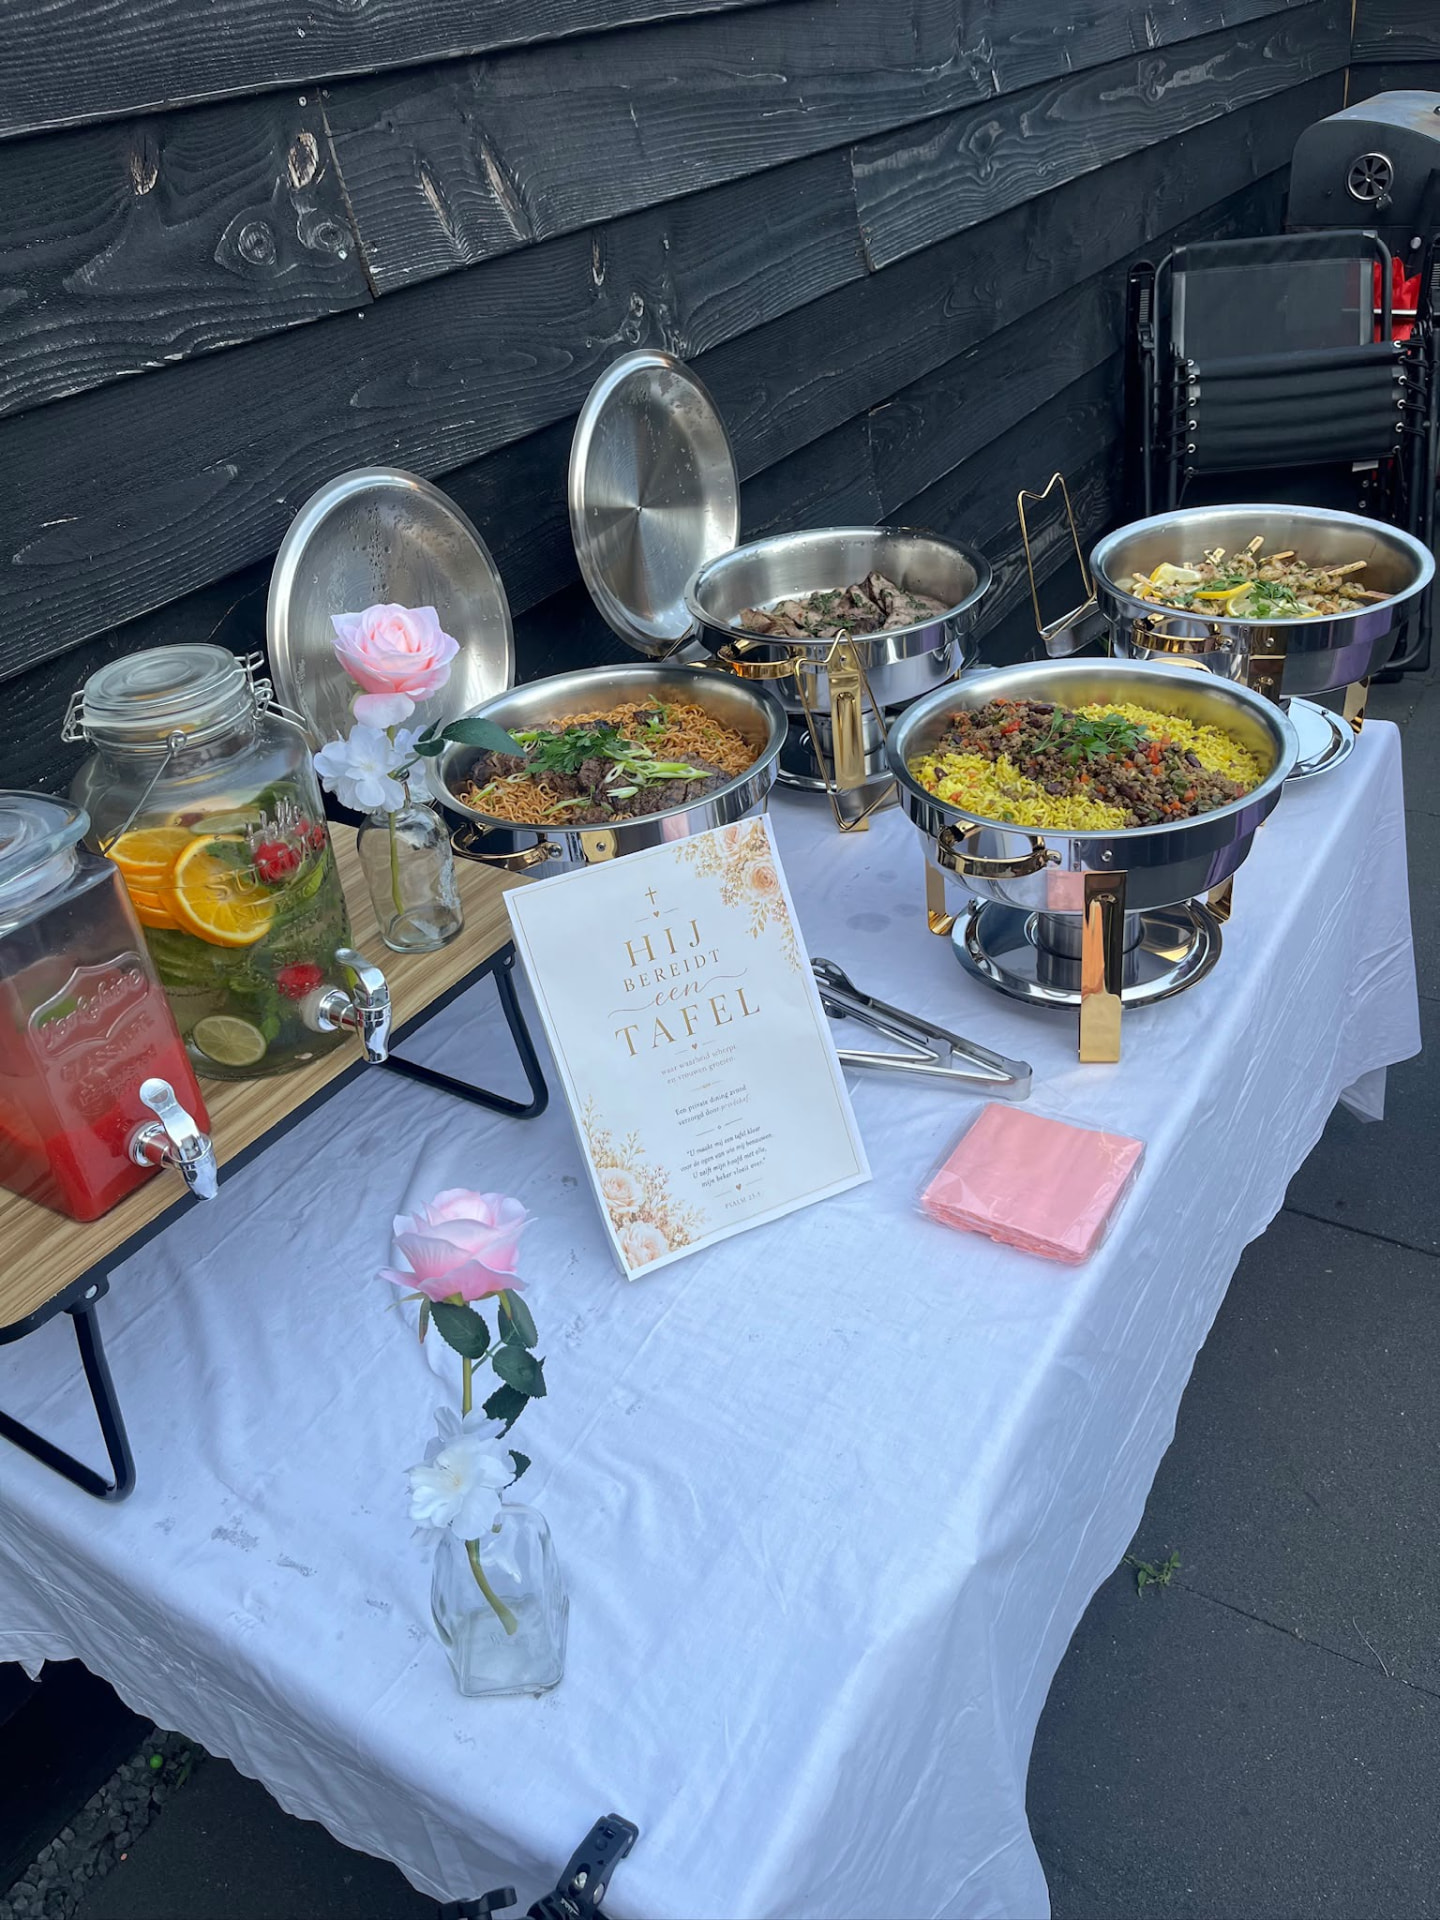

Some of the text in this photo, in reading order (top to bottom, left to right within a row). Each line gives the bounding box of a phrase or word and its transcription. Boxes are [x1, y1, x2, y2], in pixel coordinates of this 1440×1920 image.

[624, 919, 701, 968] HIJ
[623, 949, 720, 993] BEREIDT
[614, 987, 760, 1057] TAFEL
